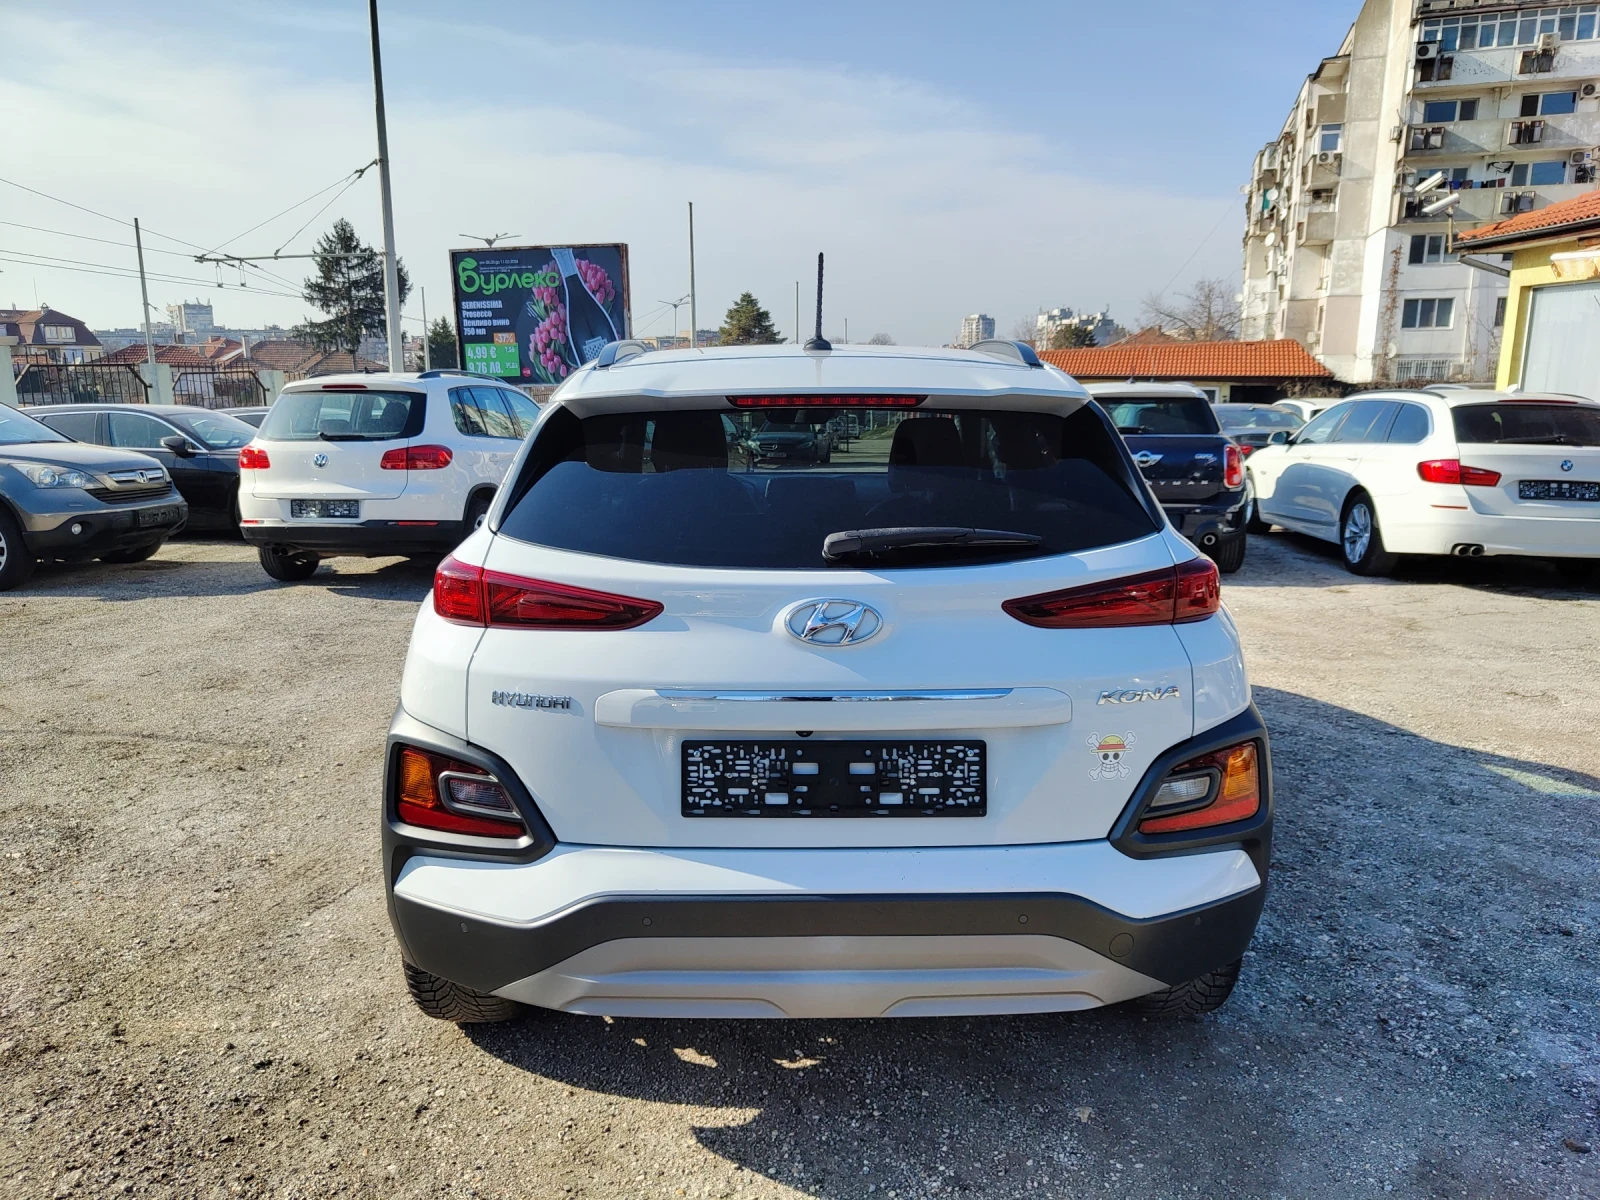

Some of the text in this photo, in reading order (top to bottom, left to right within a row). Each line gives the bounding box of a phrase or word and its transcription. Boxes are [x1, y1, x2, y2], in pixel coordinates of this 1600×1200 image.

[461, 300, 503, 310] SERENISSIMA
[462, 310, 493, 318] Prosecco
[463, 318, 510, 327] Пенливо вино
[463, 327, 476, 336] 750
[495, 333, 514, 343] -37%
[467, 346, 497, 359] 4.99 €
[468, 361, 488, 374] 9.76
[491, 690, 571, 710] HYUNDAI
[1096, 685, 1180, 705] KONA
